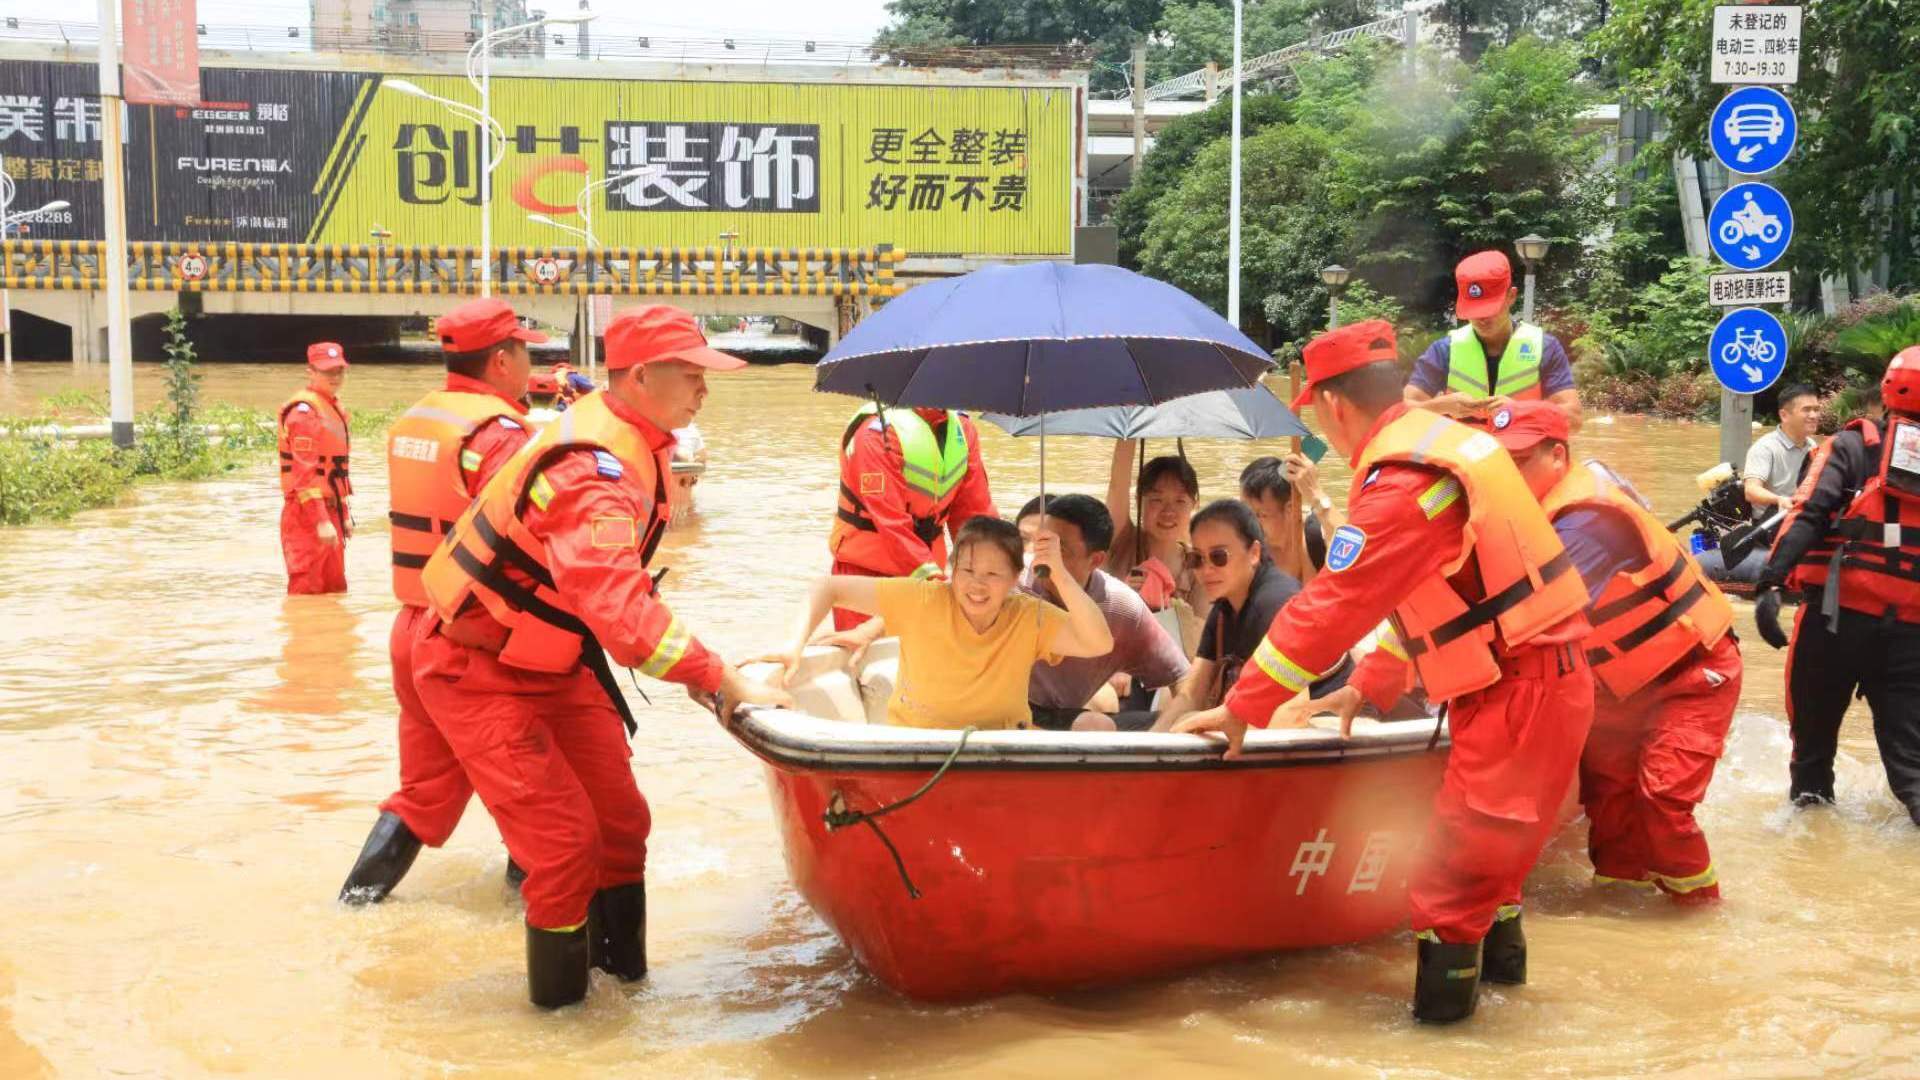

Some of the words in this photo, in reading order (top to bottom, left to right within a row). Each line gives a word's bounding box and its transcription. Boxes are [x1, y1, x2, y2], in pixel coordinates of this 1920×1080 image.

[1729, 13, 1787, 31] 未登记的
[1716, 37, 1799, 55] 电动三、四轮车
[1724, 61, 1786, 76] 7:30-19:30
[191, 109, 250, 120] EGGER
[864, 127, 1027, 166] 更全整装
[864, 173, 1027, 212] 好而不贵
[1713, 276, 1786, 301] 电动轻便摩托车
[1288, 828, 1425, 895] 中国
